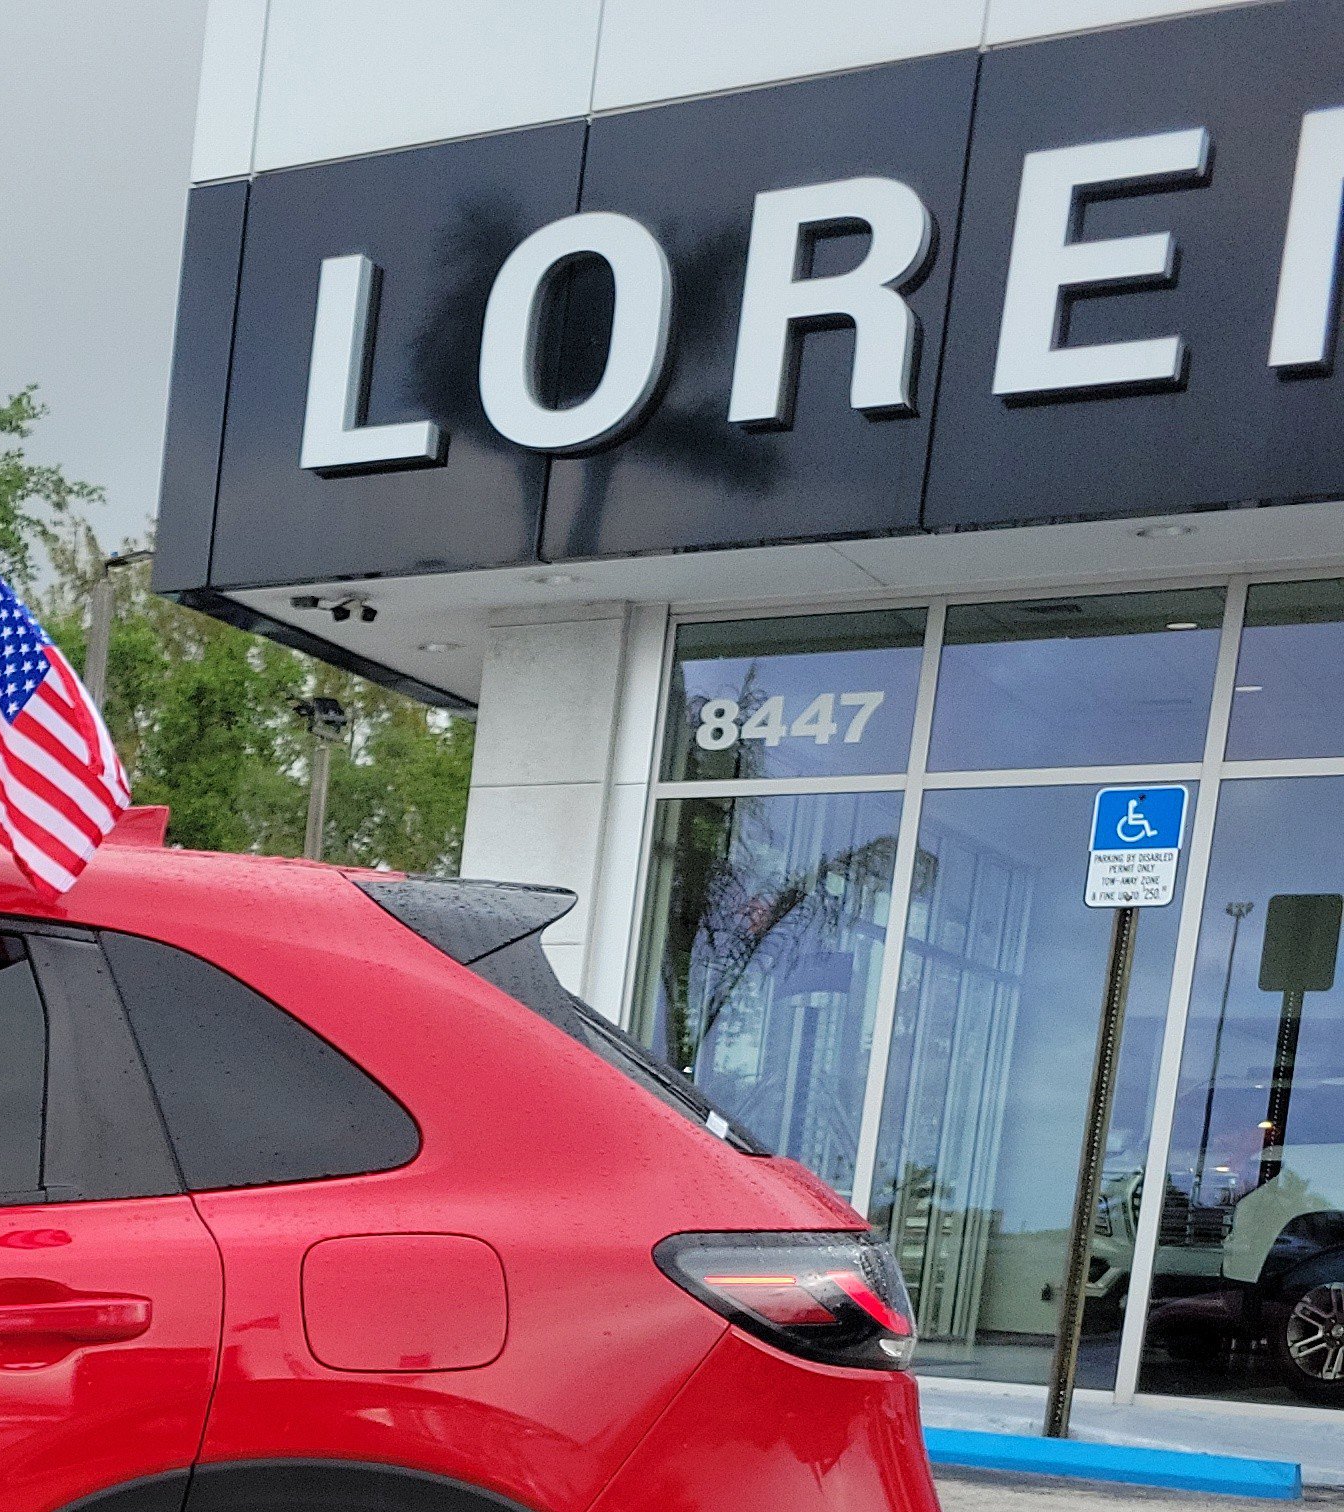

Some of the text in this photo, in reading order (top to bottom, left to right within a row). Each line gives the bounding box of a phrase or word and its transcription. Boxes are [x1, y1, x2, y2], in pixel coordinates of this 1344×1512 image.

[696, 691, 885, 750] 8447
[1094, 853, 1173, 862] PARKING BY DISABLED
[1137, 864, 1155, 872] ONLY
[1141, 876, 1160, 884] ZONE
